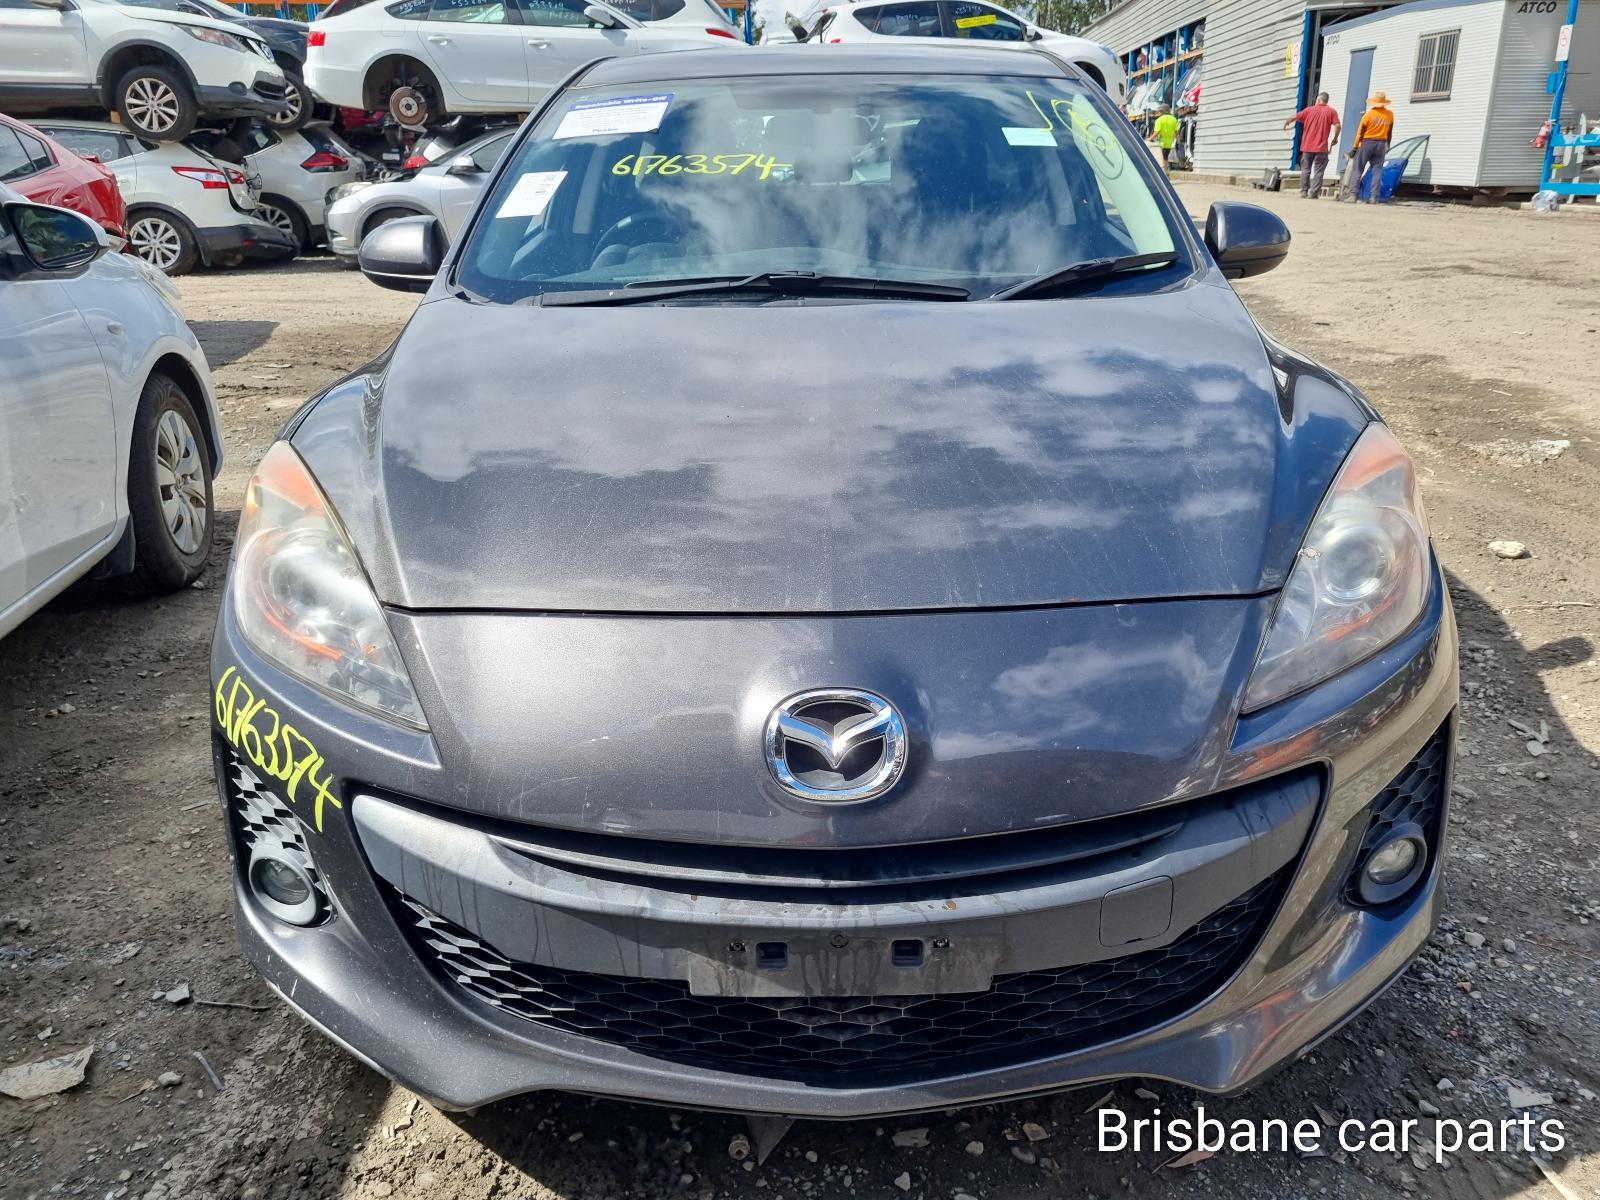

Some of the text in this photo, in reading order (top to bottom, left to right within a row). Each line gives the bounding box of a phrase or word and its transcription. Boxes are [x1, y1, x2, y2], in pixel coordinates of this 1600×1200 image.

[1517, 1, 1557, 13] ATCO
[612, 154, 793, 180] 61763574
[216, 665, 343, 833] 61763574
